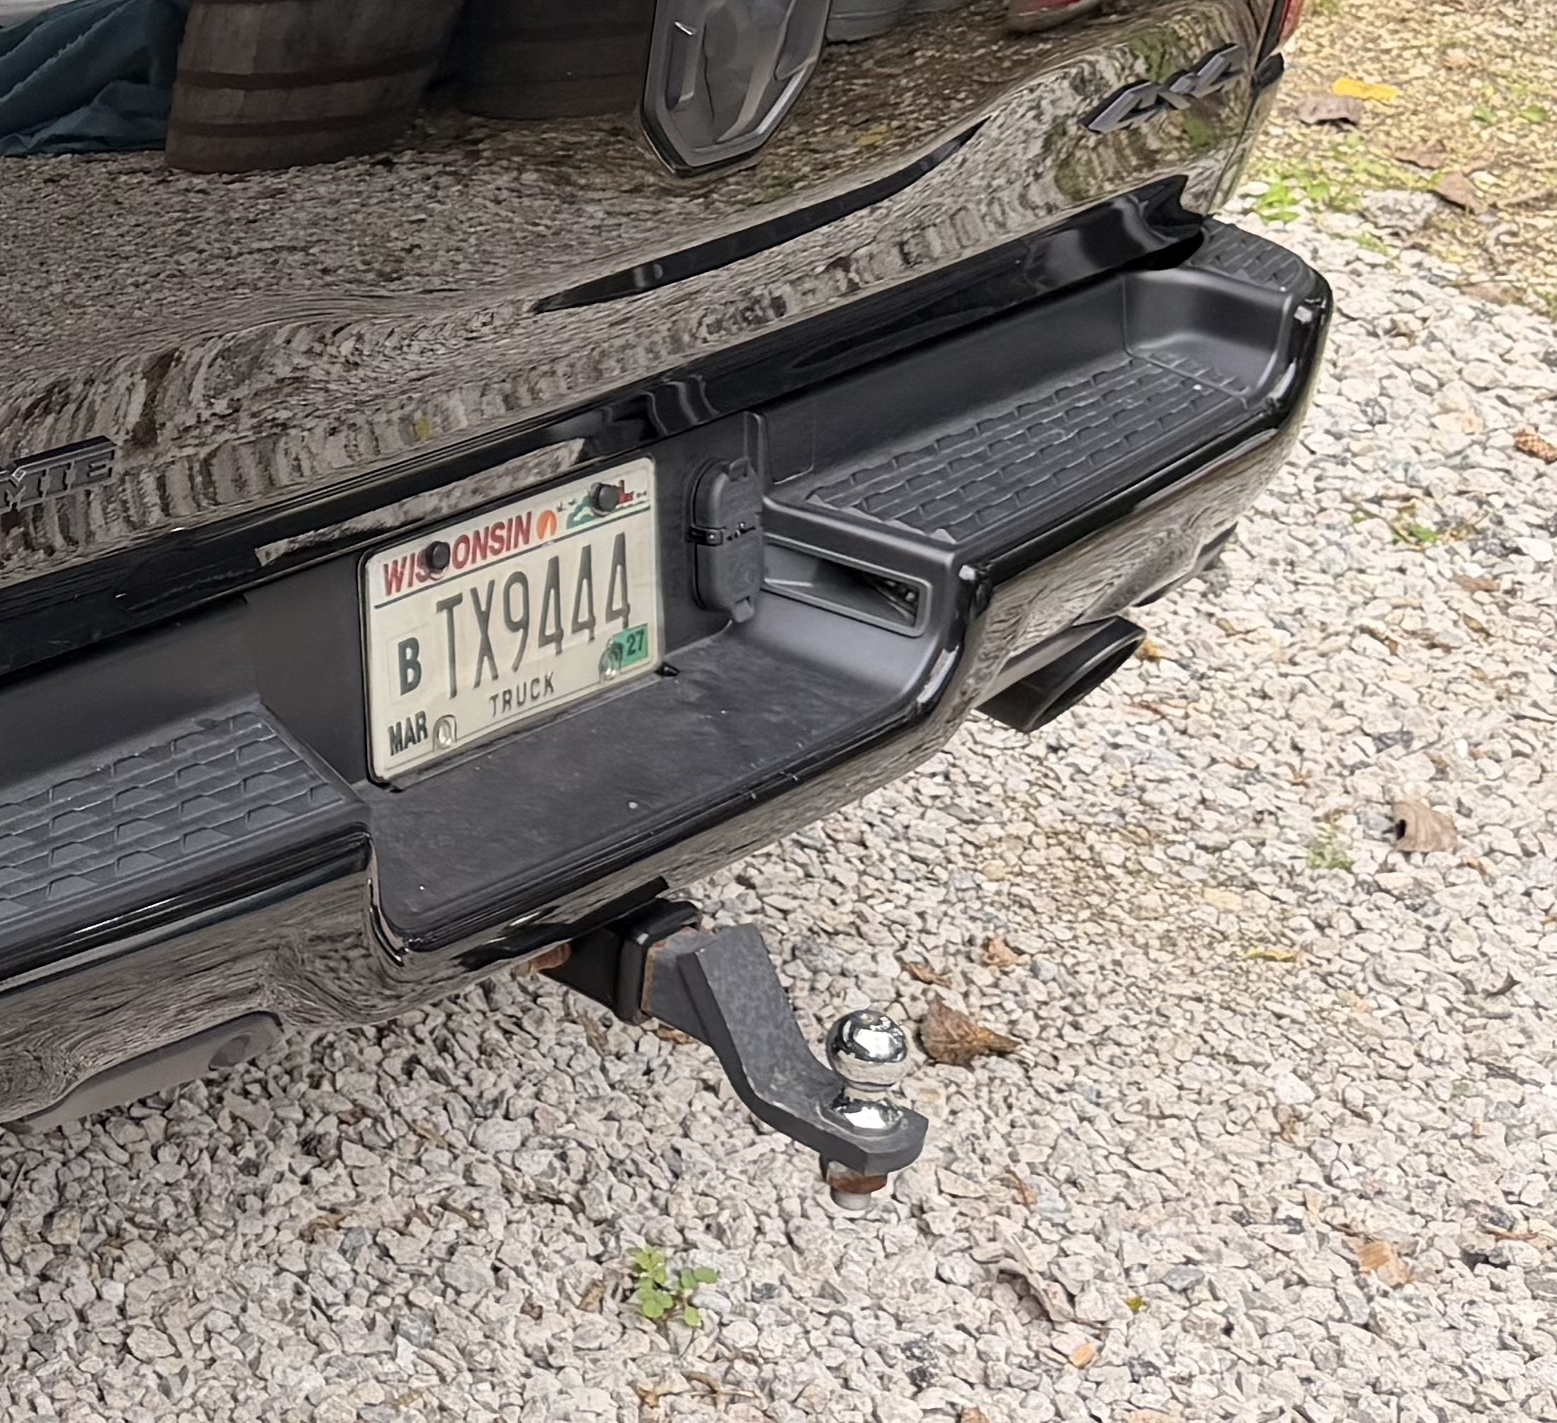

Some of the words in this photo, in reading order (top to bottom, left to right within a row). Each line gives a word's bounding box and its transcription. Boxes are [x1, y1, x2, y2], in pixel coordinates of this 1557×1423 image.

[383, 511, 533, 597] WISONSIN
[397, 637, 422, 697] B
[436, 532, 630, 699] TX9444
[626, 629, 645, 656] 27
[490, 672, 555, 718] TRUCK
[388, 710, 428, 756] MAR
